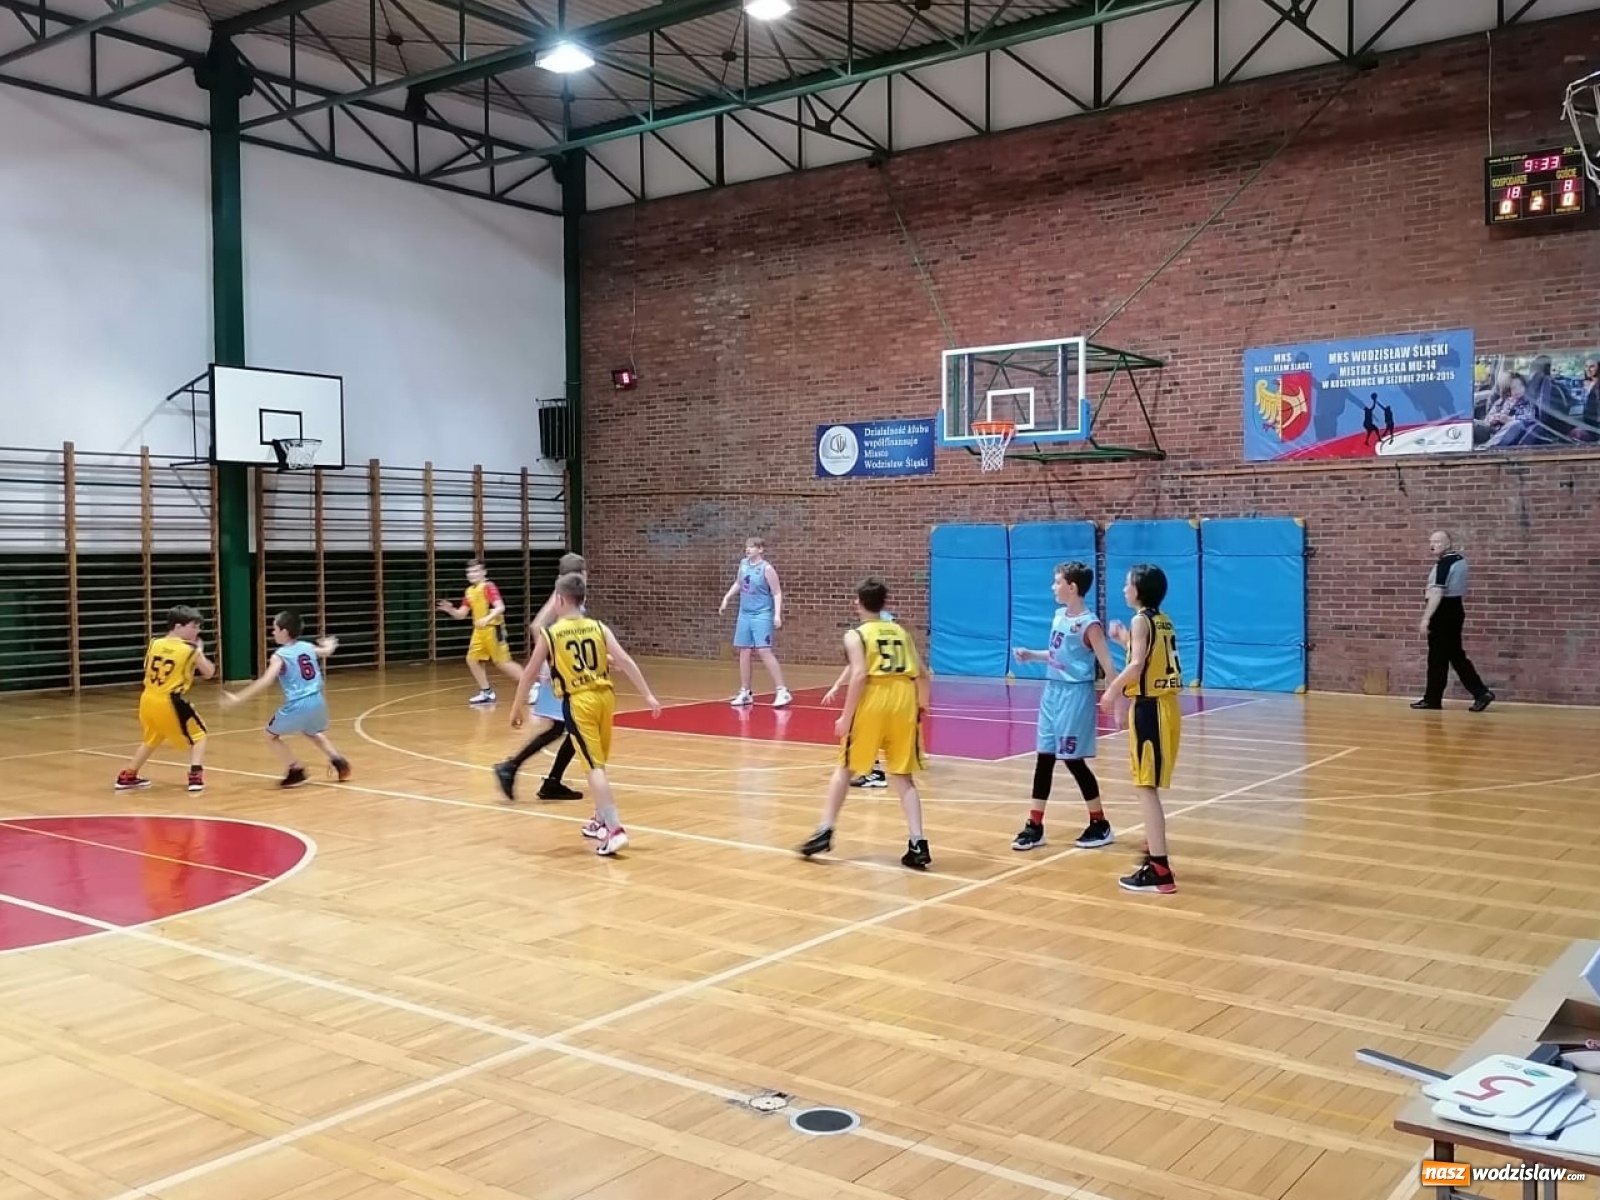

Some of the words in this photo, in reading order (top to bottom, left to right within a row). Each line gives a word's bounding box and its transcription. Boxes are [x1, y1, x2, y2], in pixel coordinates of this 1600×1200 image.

[1524, 156, 1560, 172] 9:33
[1506, 186, 1521, 198] 18
[1563, 179, 1573, 191] 8
[1530, 196, 1543, 211] 2
[1273, 353, 1292, 363] MKS
[1327, 351, 1350, 365] MKS
[1351, 346, 1411, 362] WODZISŁAW
[1413, 343, 1448, 359] ŚLĄSKI
[1340, 364, 1371, 376] MISTRZ
[1408, 359, 1436, 372] MU-14
[1321, 380, 1330, 389] W
[1415, 370, 1456, 383] 2014-2015
[565, 638, 598, 673] 30
[297, 653, 317, 681] 6
[1453, 1075, 1536, 1101] 5
